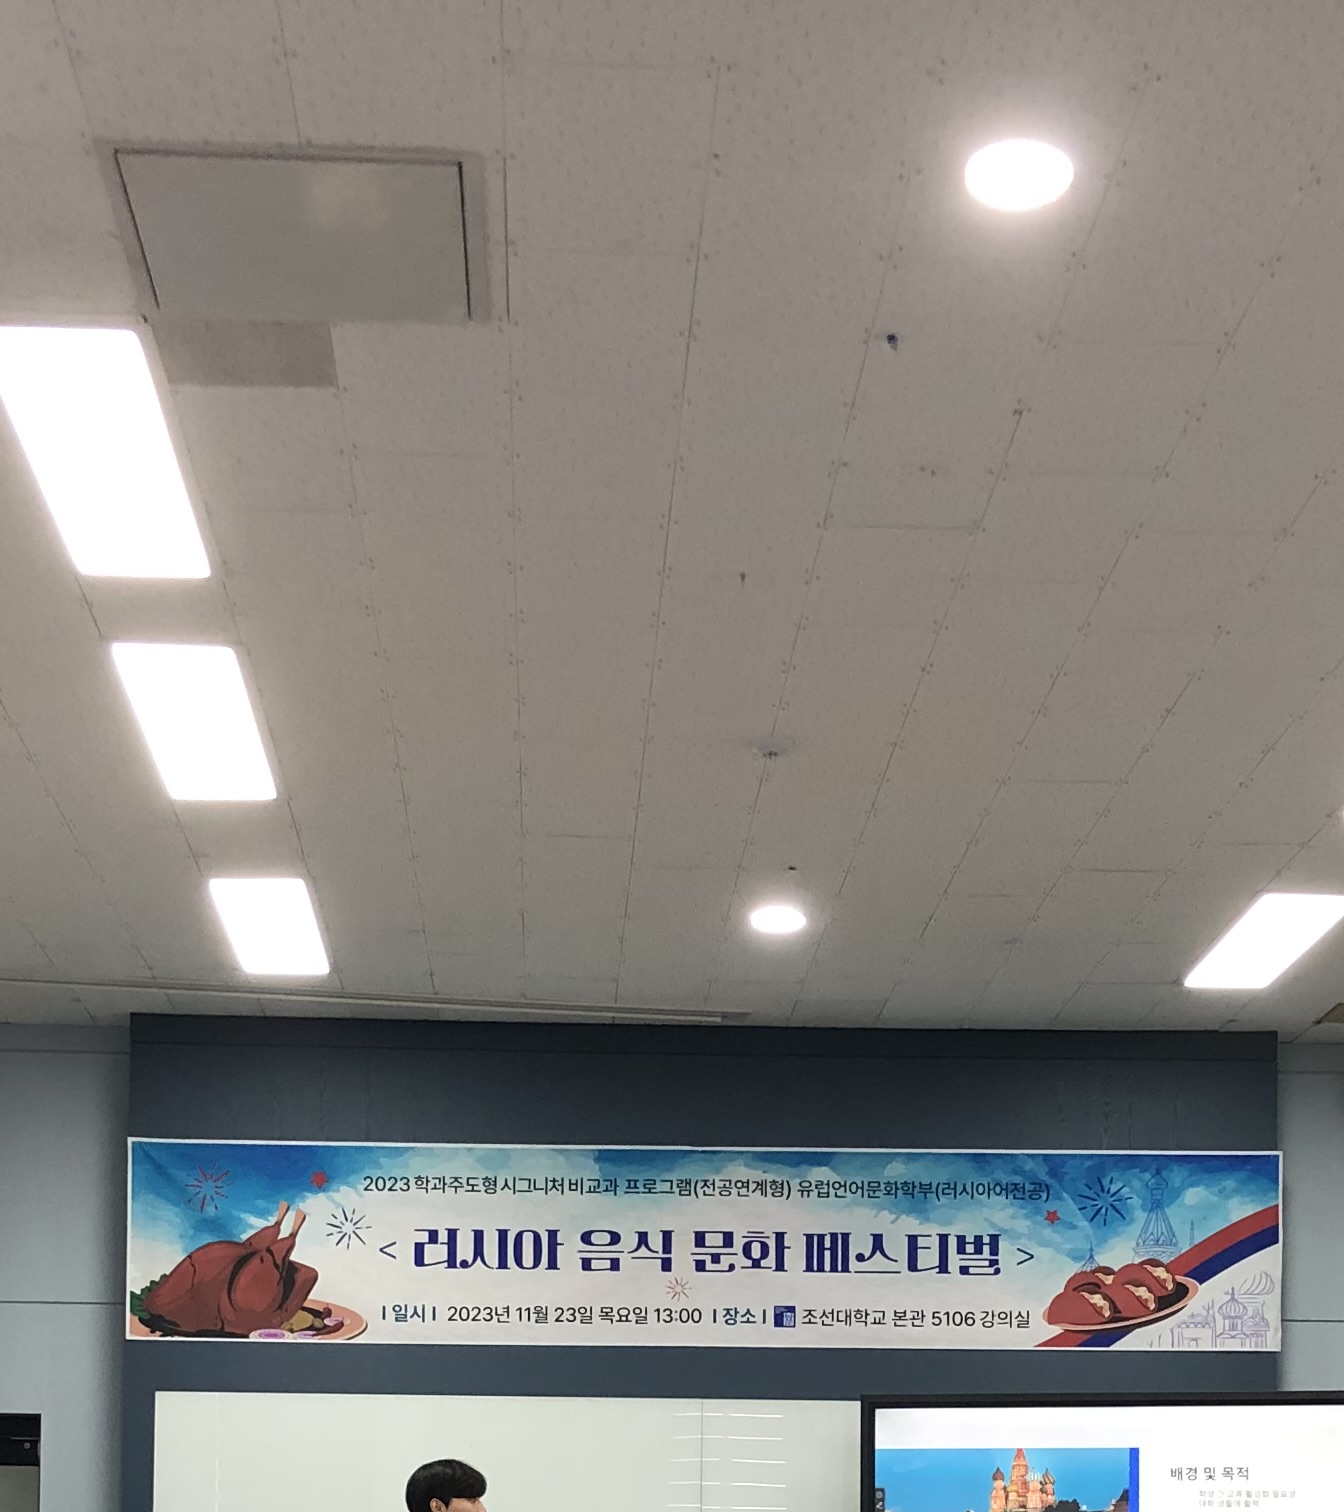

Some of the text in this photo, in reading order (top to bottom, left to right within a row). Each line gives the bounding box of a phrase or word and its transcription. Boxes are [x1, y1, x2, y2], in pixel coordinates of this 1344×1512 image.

[363, 1175, 411, 1192] 2023
[414, 1175, 498, 1195] 학과주도형
[500, 1176, 565, 1195] 시그니처
[568, 1177, 619, 1196] 비교과
[413, 1227, 565, 1271] 러시아
[576, 1228, 676, 1272] 음식
[690, 1230, 792, 1273] 문화
[802, 1231, 1002, 1276] 페스티벌
[447, 1305, 511, 1324] 2023년
[515, 1305, 549, 1325] 11월
[554, 1305, 593, 1325] 23일
[598, 1306, 649, 1325] 목요일
[653, 1307, 703, 1324] 13:00
[801, 1308, 887, 1327] 조선대학교
[892, 1309, 926, 1328] 본관
[931, 1310, 976, 1327] 5106
[979, 1309, 1031, 1329] 강의실
[1170, 1466, 1250, 1481] 배경 및 목적
